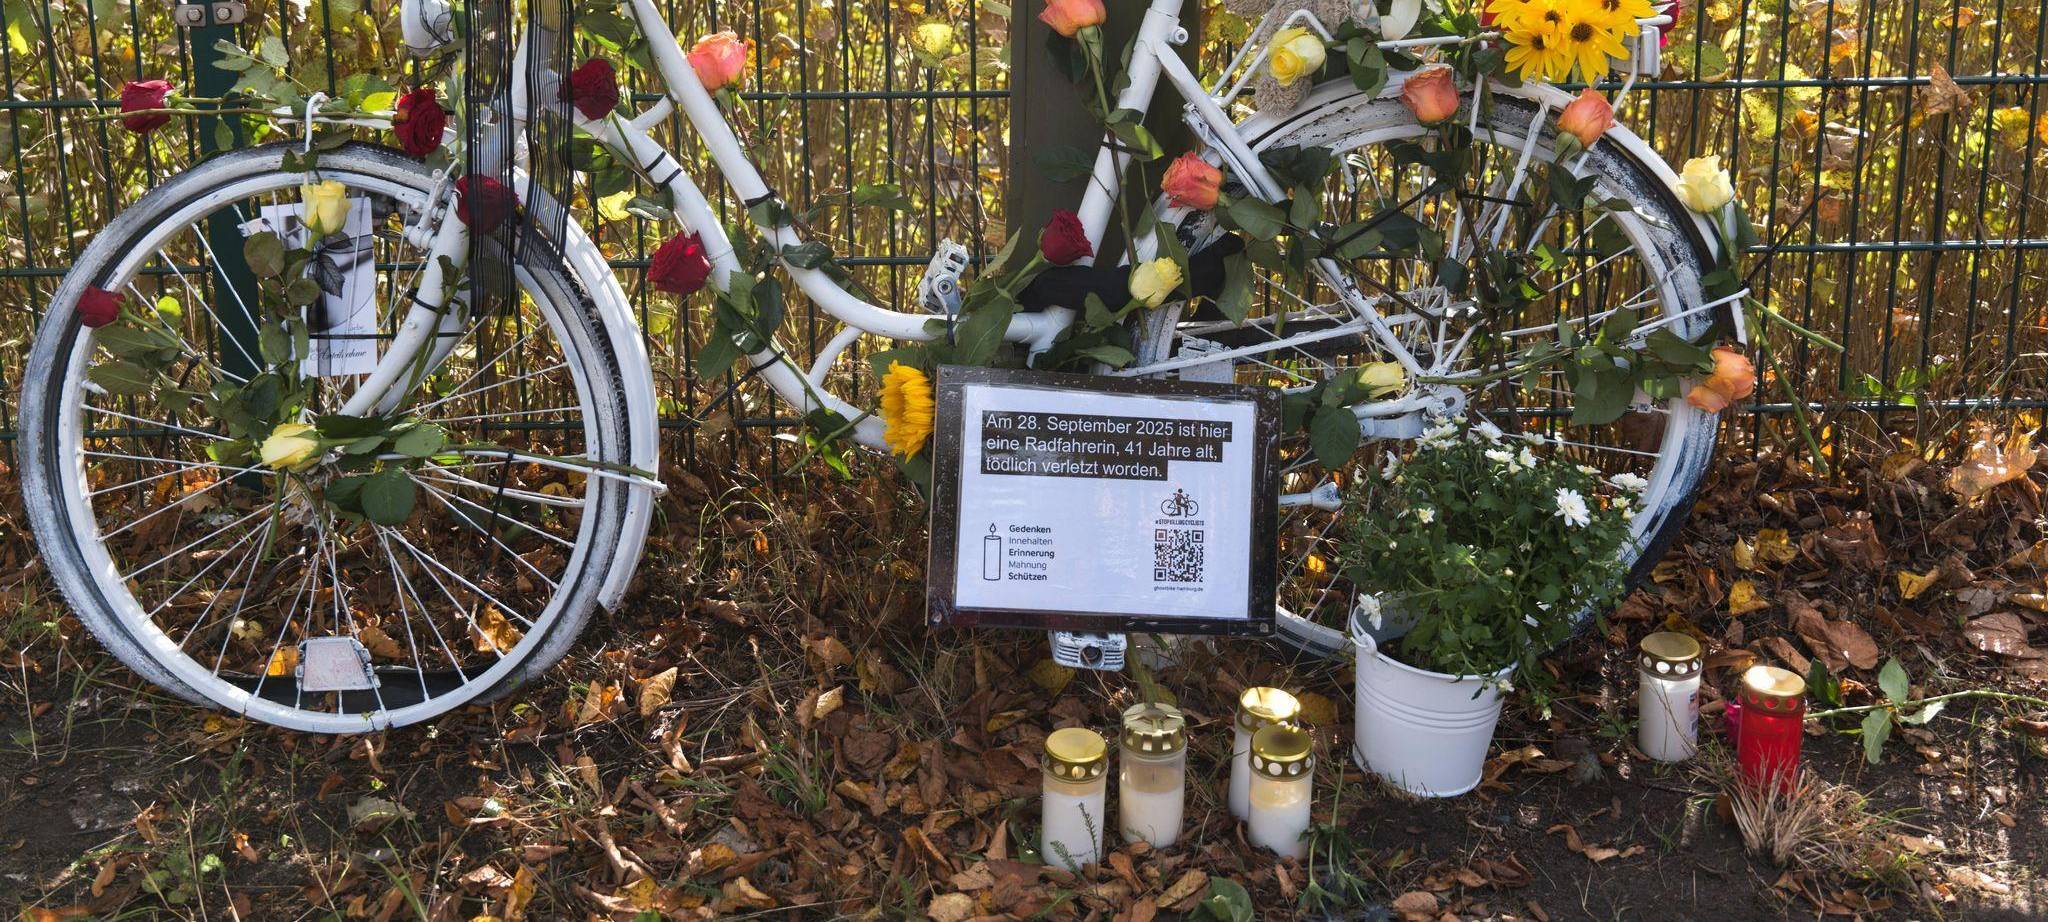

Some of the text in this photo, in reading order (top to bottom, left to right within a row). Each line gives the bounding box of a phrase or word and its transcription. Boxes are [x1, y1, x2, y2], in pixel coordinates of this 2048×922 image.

[985, 413, 1228, 438] Am 28. September 2025 ist hier
[986, 435, 1218, 460] eine Radfahrerin, 41 Jahre alt,
[985, 457, 1163, 477] tödlich verletzt worden.
[1008, 524, 1052, 534] Gedenken
[1008, 536, 1053, 546] Innehalten
[1008, 548, 1055, 560] Erinnerung
[1008, 560, 1047, 571] Mahnung
[1008, 571, 1048, 581] Schützen
